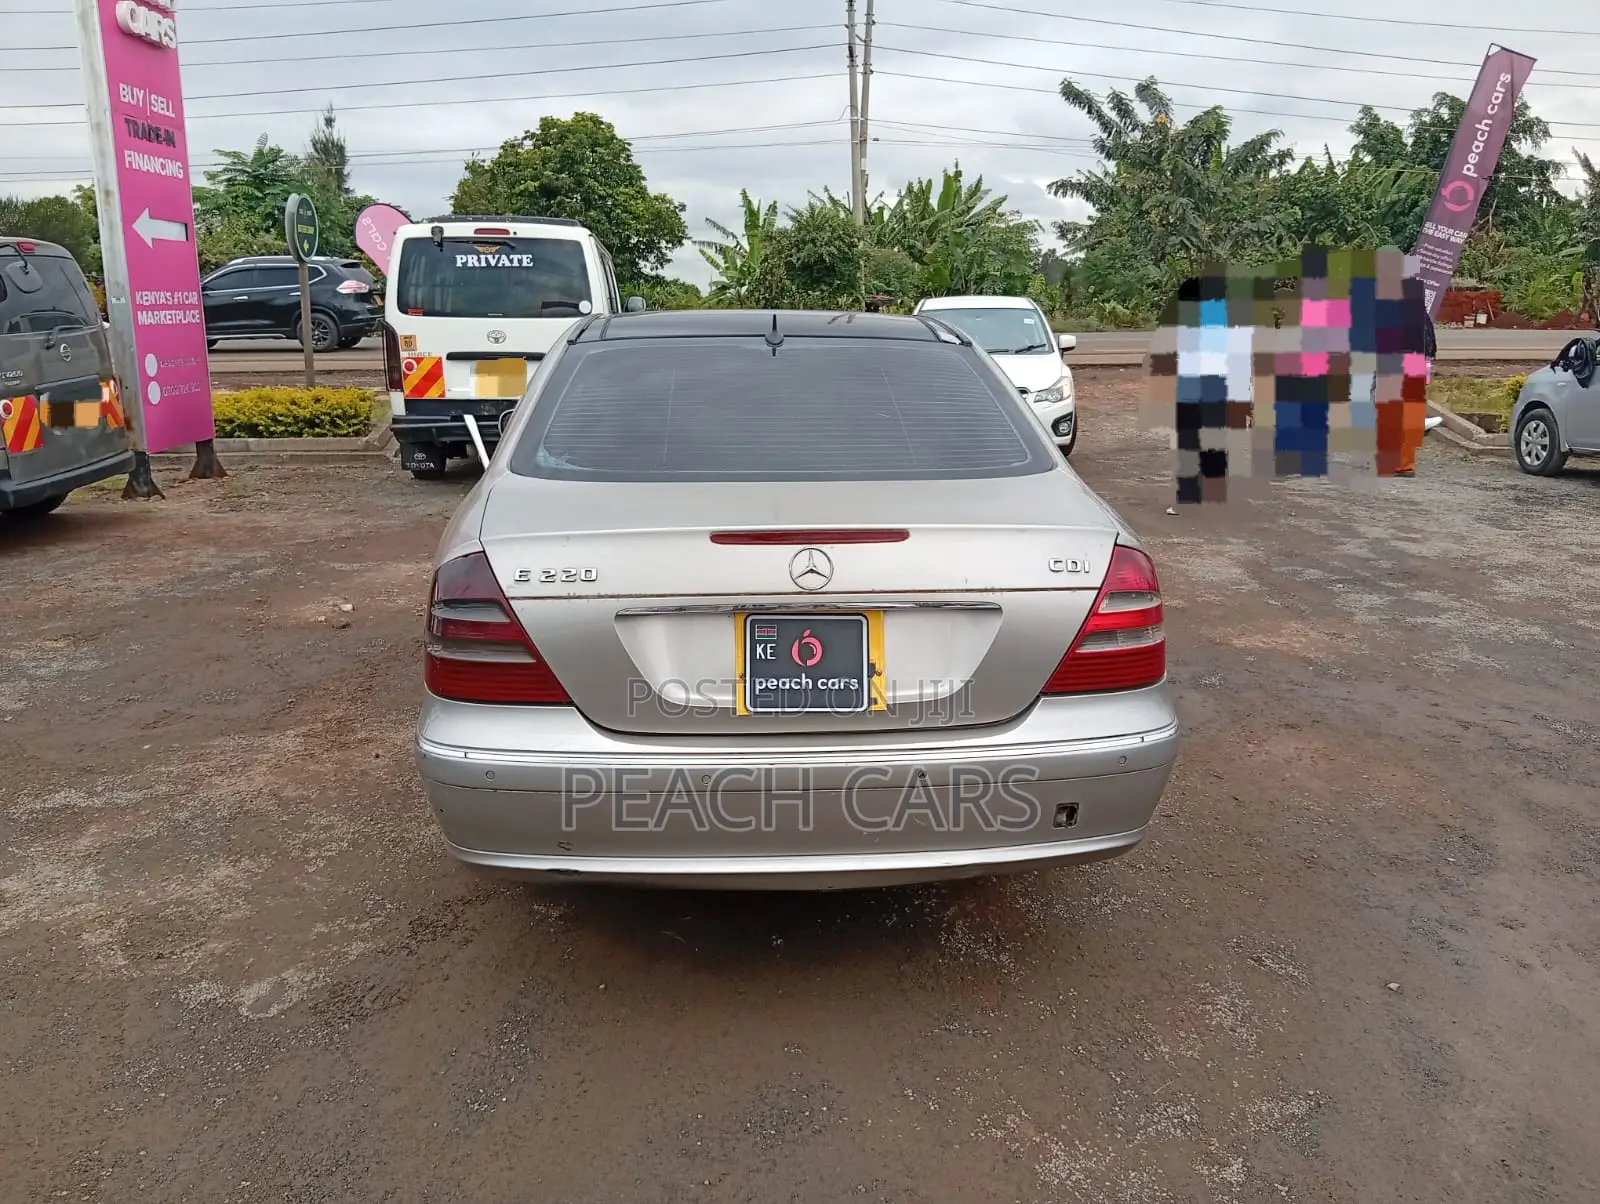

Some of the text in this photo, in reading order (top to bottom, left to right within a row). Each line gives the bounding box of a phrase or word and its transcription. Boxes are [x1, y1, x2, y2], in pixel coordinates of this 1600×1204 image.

[116, 1, 177, 49] CARS
[119, 82, 176, 119] BUY SELL
[123, 117, 177, 149] TRADE-IN
[1462, 72, 1512, 178] peach cars
[124, 149, 184, 179] FINANCING
[455, 254, 534, 267] PRIVATE
[135, 291, 173, 306] KENYA'S
[183, 291, 199, 305] CAR
[137, 309, 201, 326] MARKETPLACE
[514, 567, 598, 583] E 220
[1048, 558, 1091, 574] CDI
[756, 643, 777, 660] KE
[755, 672, 859, 695] peach cars
